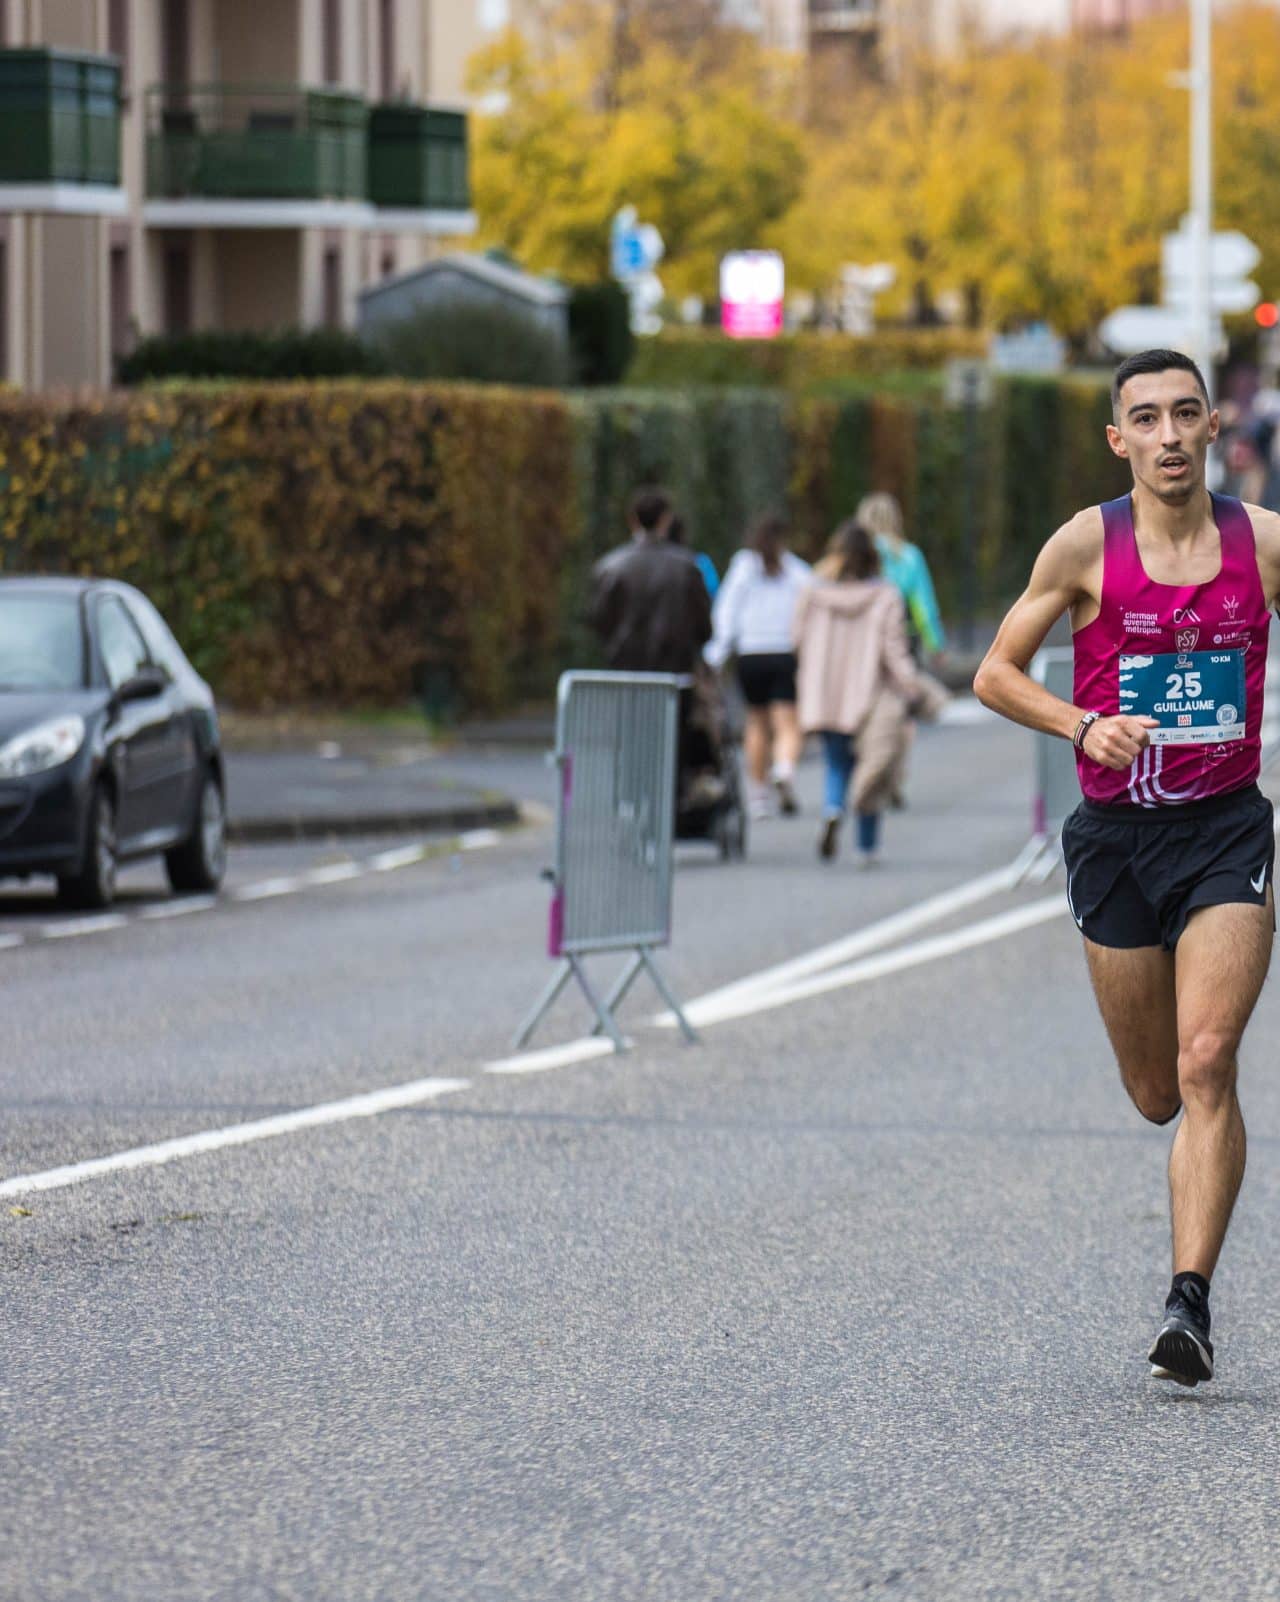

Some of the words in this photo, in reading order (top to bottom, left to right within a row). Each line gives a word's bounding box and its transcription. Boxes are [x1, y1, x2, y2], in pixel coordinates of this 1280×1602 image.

[1125, 612, 1158, 620] clermont
[1123, 618, 1156, 627] auvergne
[1125, 625, 1162, 635] métropole
[1220, 655, 1231, 663] KM
[1166, 671, 1202, 699] 25
[1153, 700, 1215, 713] GUILLAUME
